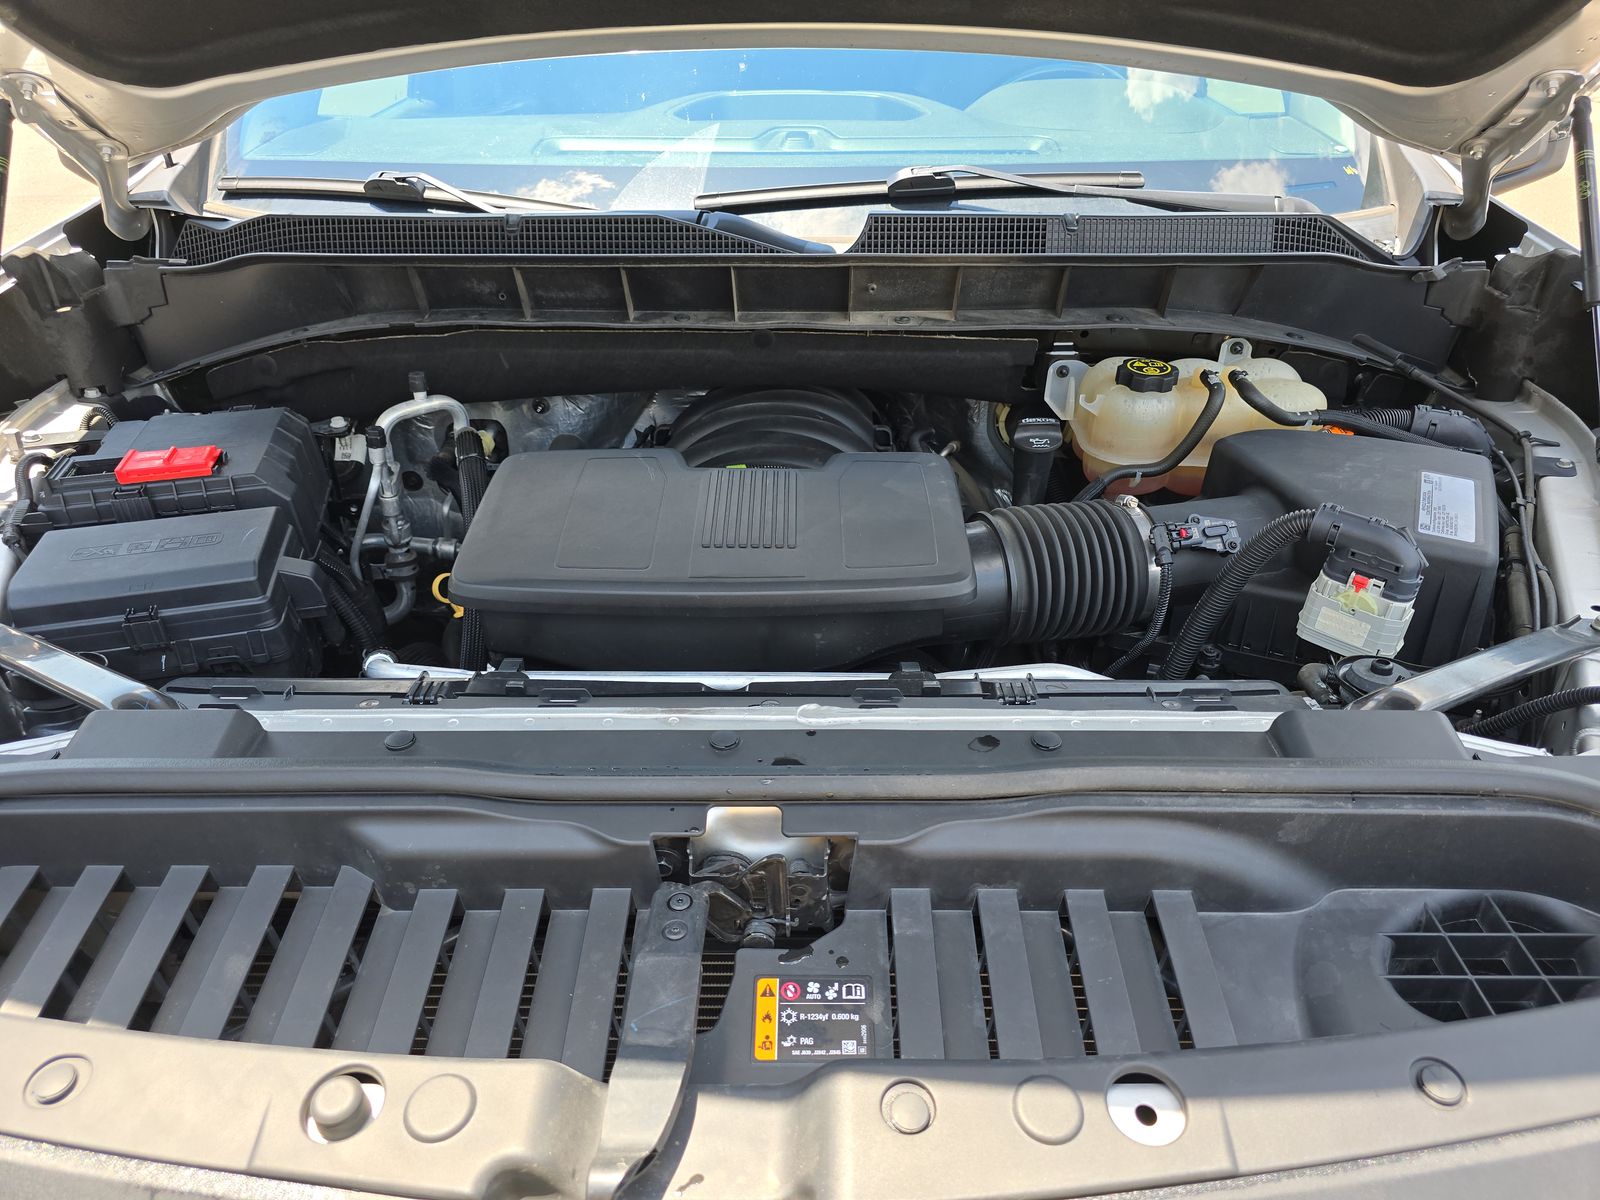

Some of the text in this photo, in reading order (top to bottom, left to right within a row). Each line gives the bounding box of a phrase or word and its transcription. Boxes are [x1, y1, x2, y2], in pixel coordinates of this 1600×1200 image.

[799, 1013, 860, 1022] R-1234yf 0.600 kg
[799, 1037, 814, 1045] PAG
